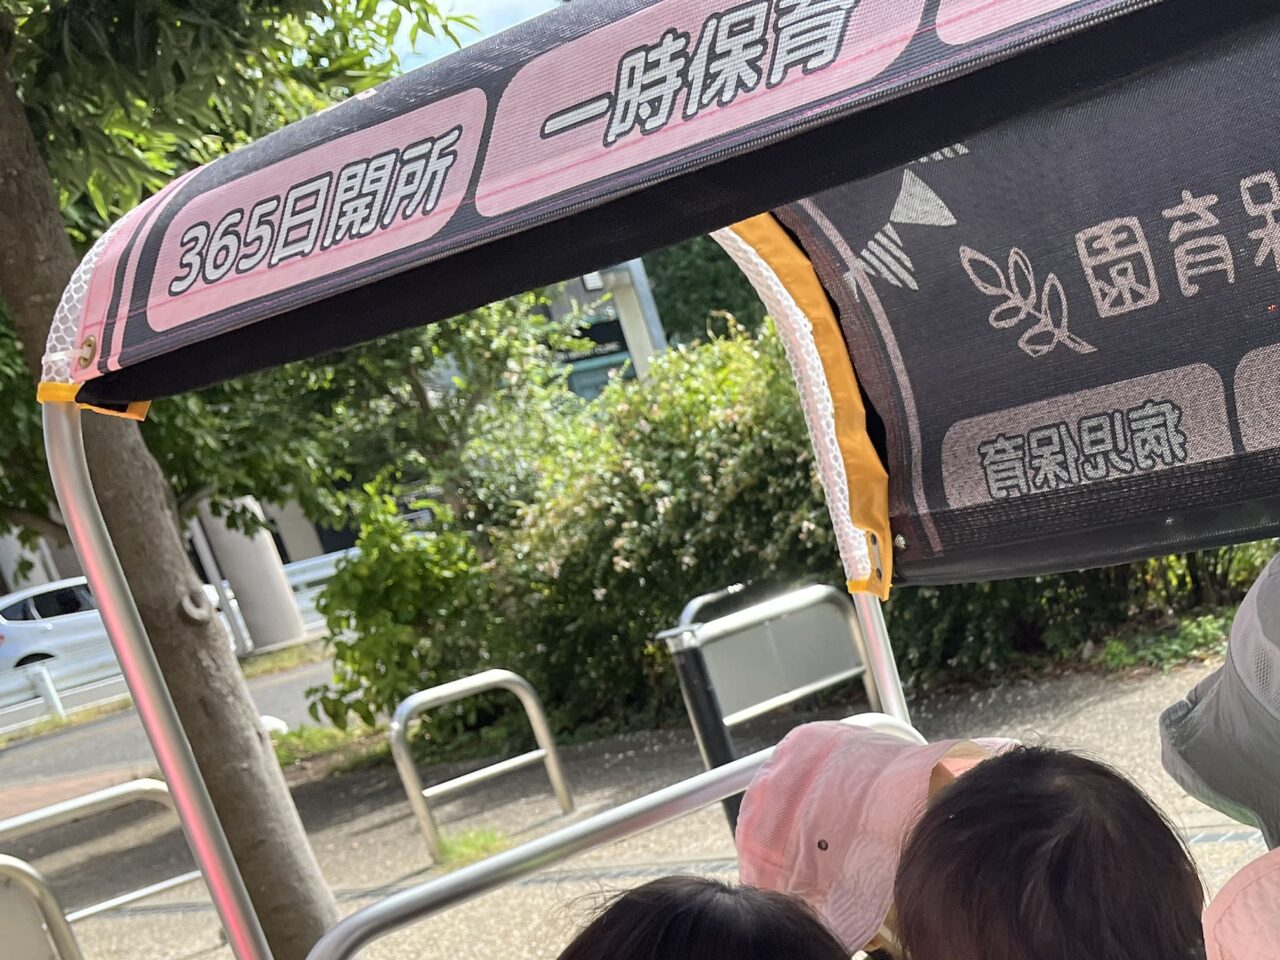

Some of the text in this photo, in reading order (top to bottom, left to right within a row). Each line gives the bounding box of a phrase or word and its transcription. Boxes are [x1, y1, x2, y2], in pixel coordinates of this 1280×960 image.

[540, 0, 857, 147] 一時保育
[168, 124, 464, 296] 365日開所
